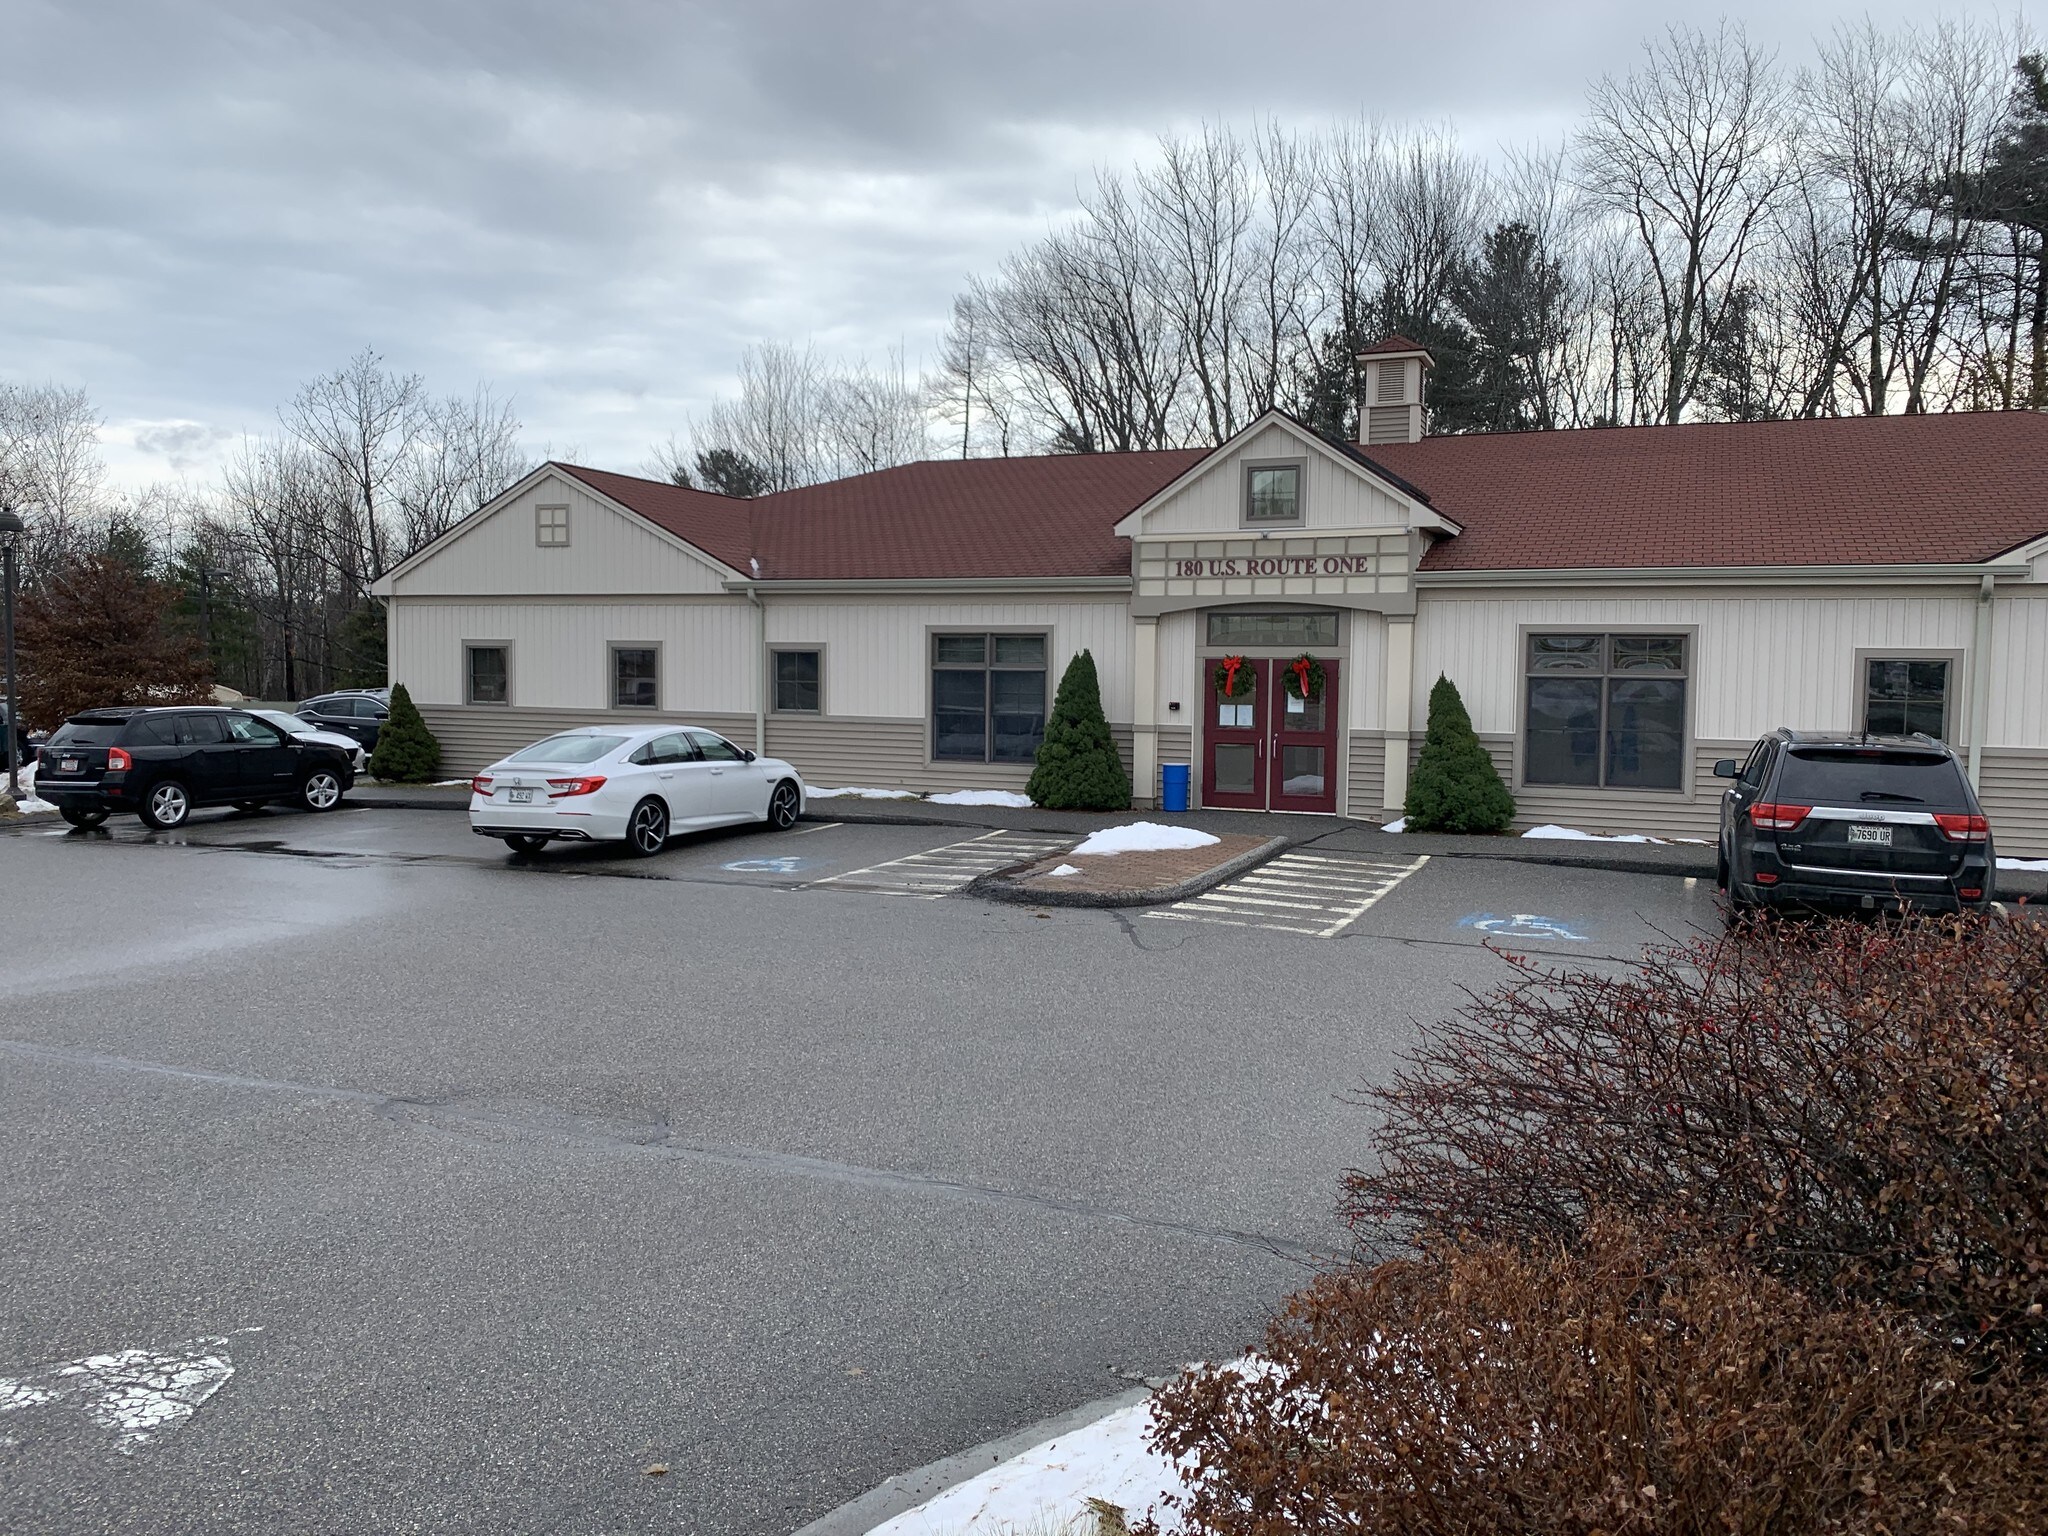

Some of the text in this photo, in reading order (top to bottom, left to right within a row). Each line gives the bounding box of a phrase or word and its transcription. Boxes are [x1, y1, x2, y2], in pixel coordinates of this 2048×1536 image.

[1175, 556, 1368, 577] 180 U.S. ROUTE ONE
[1857, 829, 1891, 842] 7690 UR
